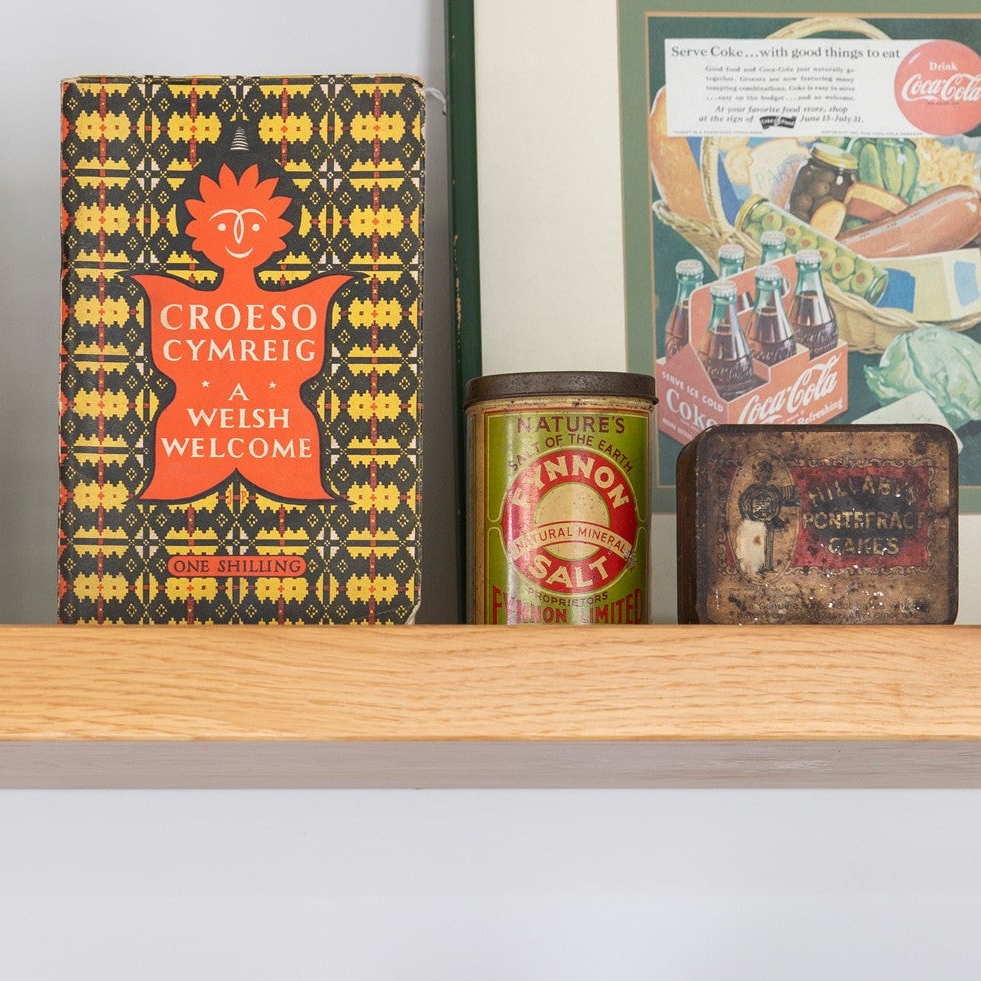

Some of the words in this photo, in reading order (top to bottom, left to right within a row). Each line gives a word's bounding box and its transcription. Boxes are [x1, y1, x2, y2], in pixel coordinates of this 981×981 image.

[671, 46, 708, 57] Serve
[791, 46, 822, 59] good
[825, 47, 864, 60] things
[867, 48, 880, 58] to
[882, 49, 901, 58] eat
[929, 61, 959, 72] Drink
[901, 73, 981, 102] Coca-Cola
[748, 105, 780, 114] favorite
[781, 105, 801, 115] food
[799, 115, 821, 123] June
[159, 302, 317, 332] CROESO
[162, 338, 316, 362] CYMREIG
[227, 383, 250, 401] A
[661, 371, 684, 390] SERVE
[686, 385, 700, 399] ICE
[701, 395, 724, 413] COLD
[737, 352, 842, 425] Coca-Cola
[187, 408, 290, 430] WELSH
[516, 415, 626, 435] NATURE'S
[161, 438, 313, 460] WELCOME
[508, 441, 540, 472] SALT
[545, 435, 564, 448] OF
[569, 433, 593, 447] THE
[598, 439, 634, 474] EARTH
[509, 454, 630, 510] FYNNON
[515, 526, 573, 552] NATURAL
[577, 526, 627, 554] MINERAL
[827, 536, 901, 557] CAKES
[173, 559, 210, 574] ONE
[217, 559, 302, 574] SHILLING
[529, 554, 608, 588] SALT
[526, 590, 609, 607] PROPRIETORS
[580, 587, 643, 625] LIMITED
